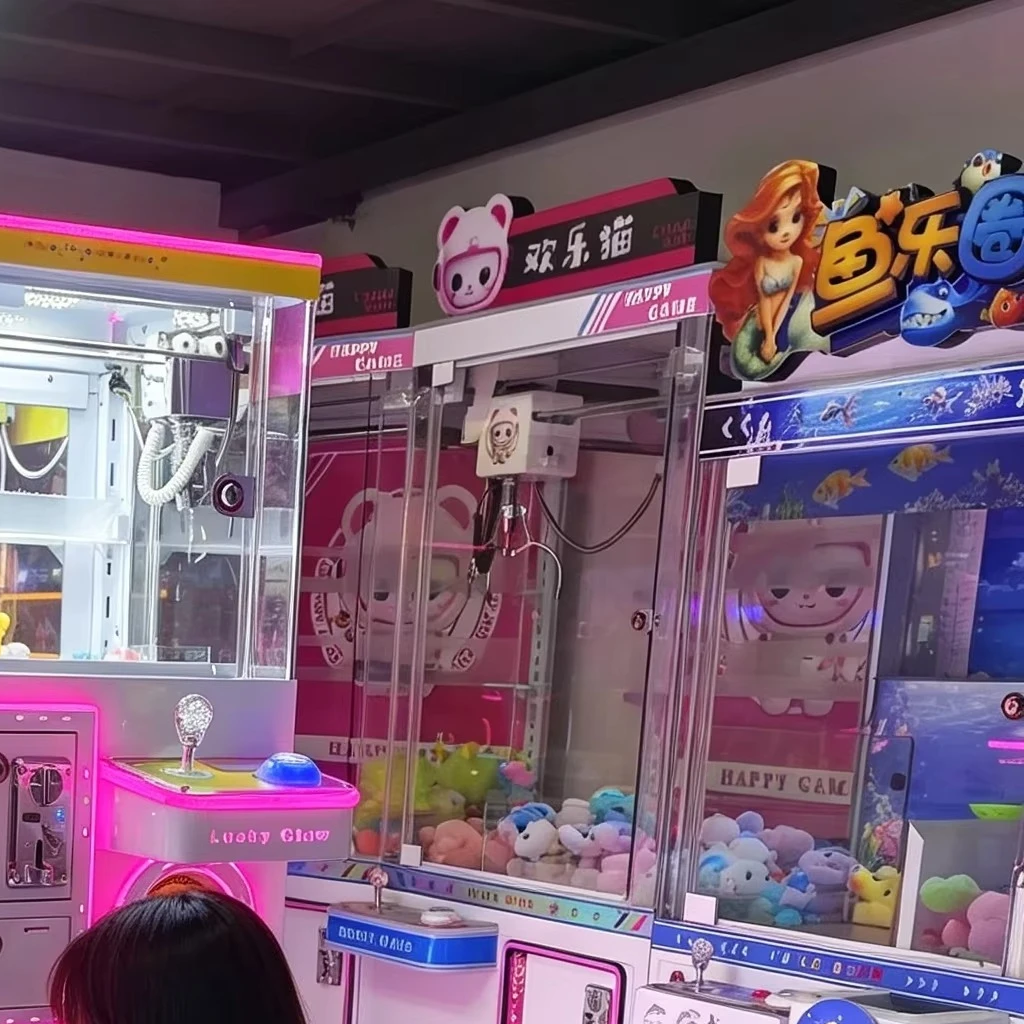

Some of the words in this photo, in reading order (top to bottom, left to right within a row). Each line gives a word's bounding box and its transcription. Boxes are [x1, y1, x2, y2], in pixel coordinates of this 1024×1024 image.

[523, 214, 634, 274] 欢乐猫
[720, 768, 787, 791] HAPPY
